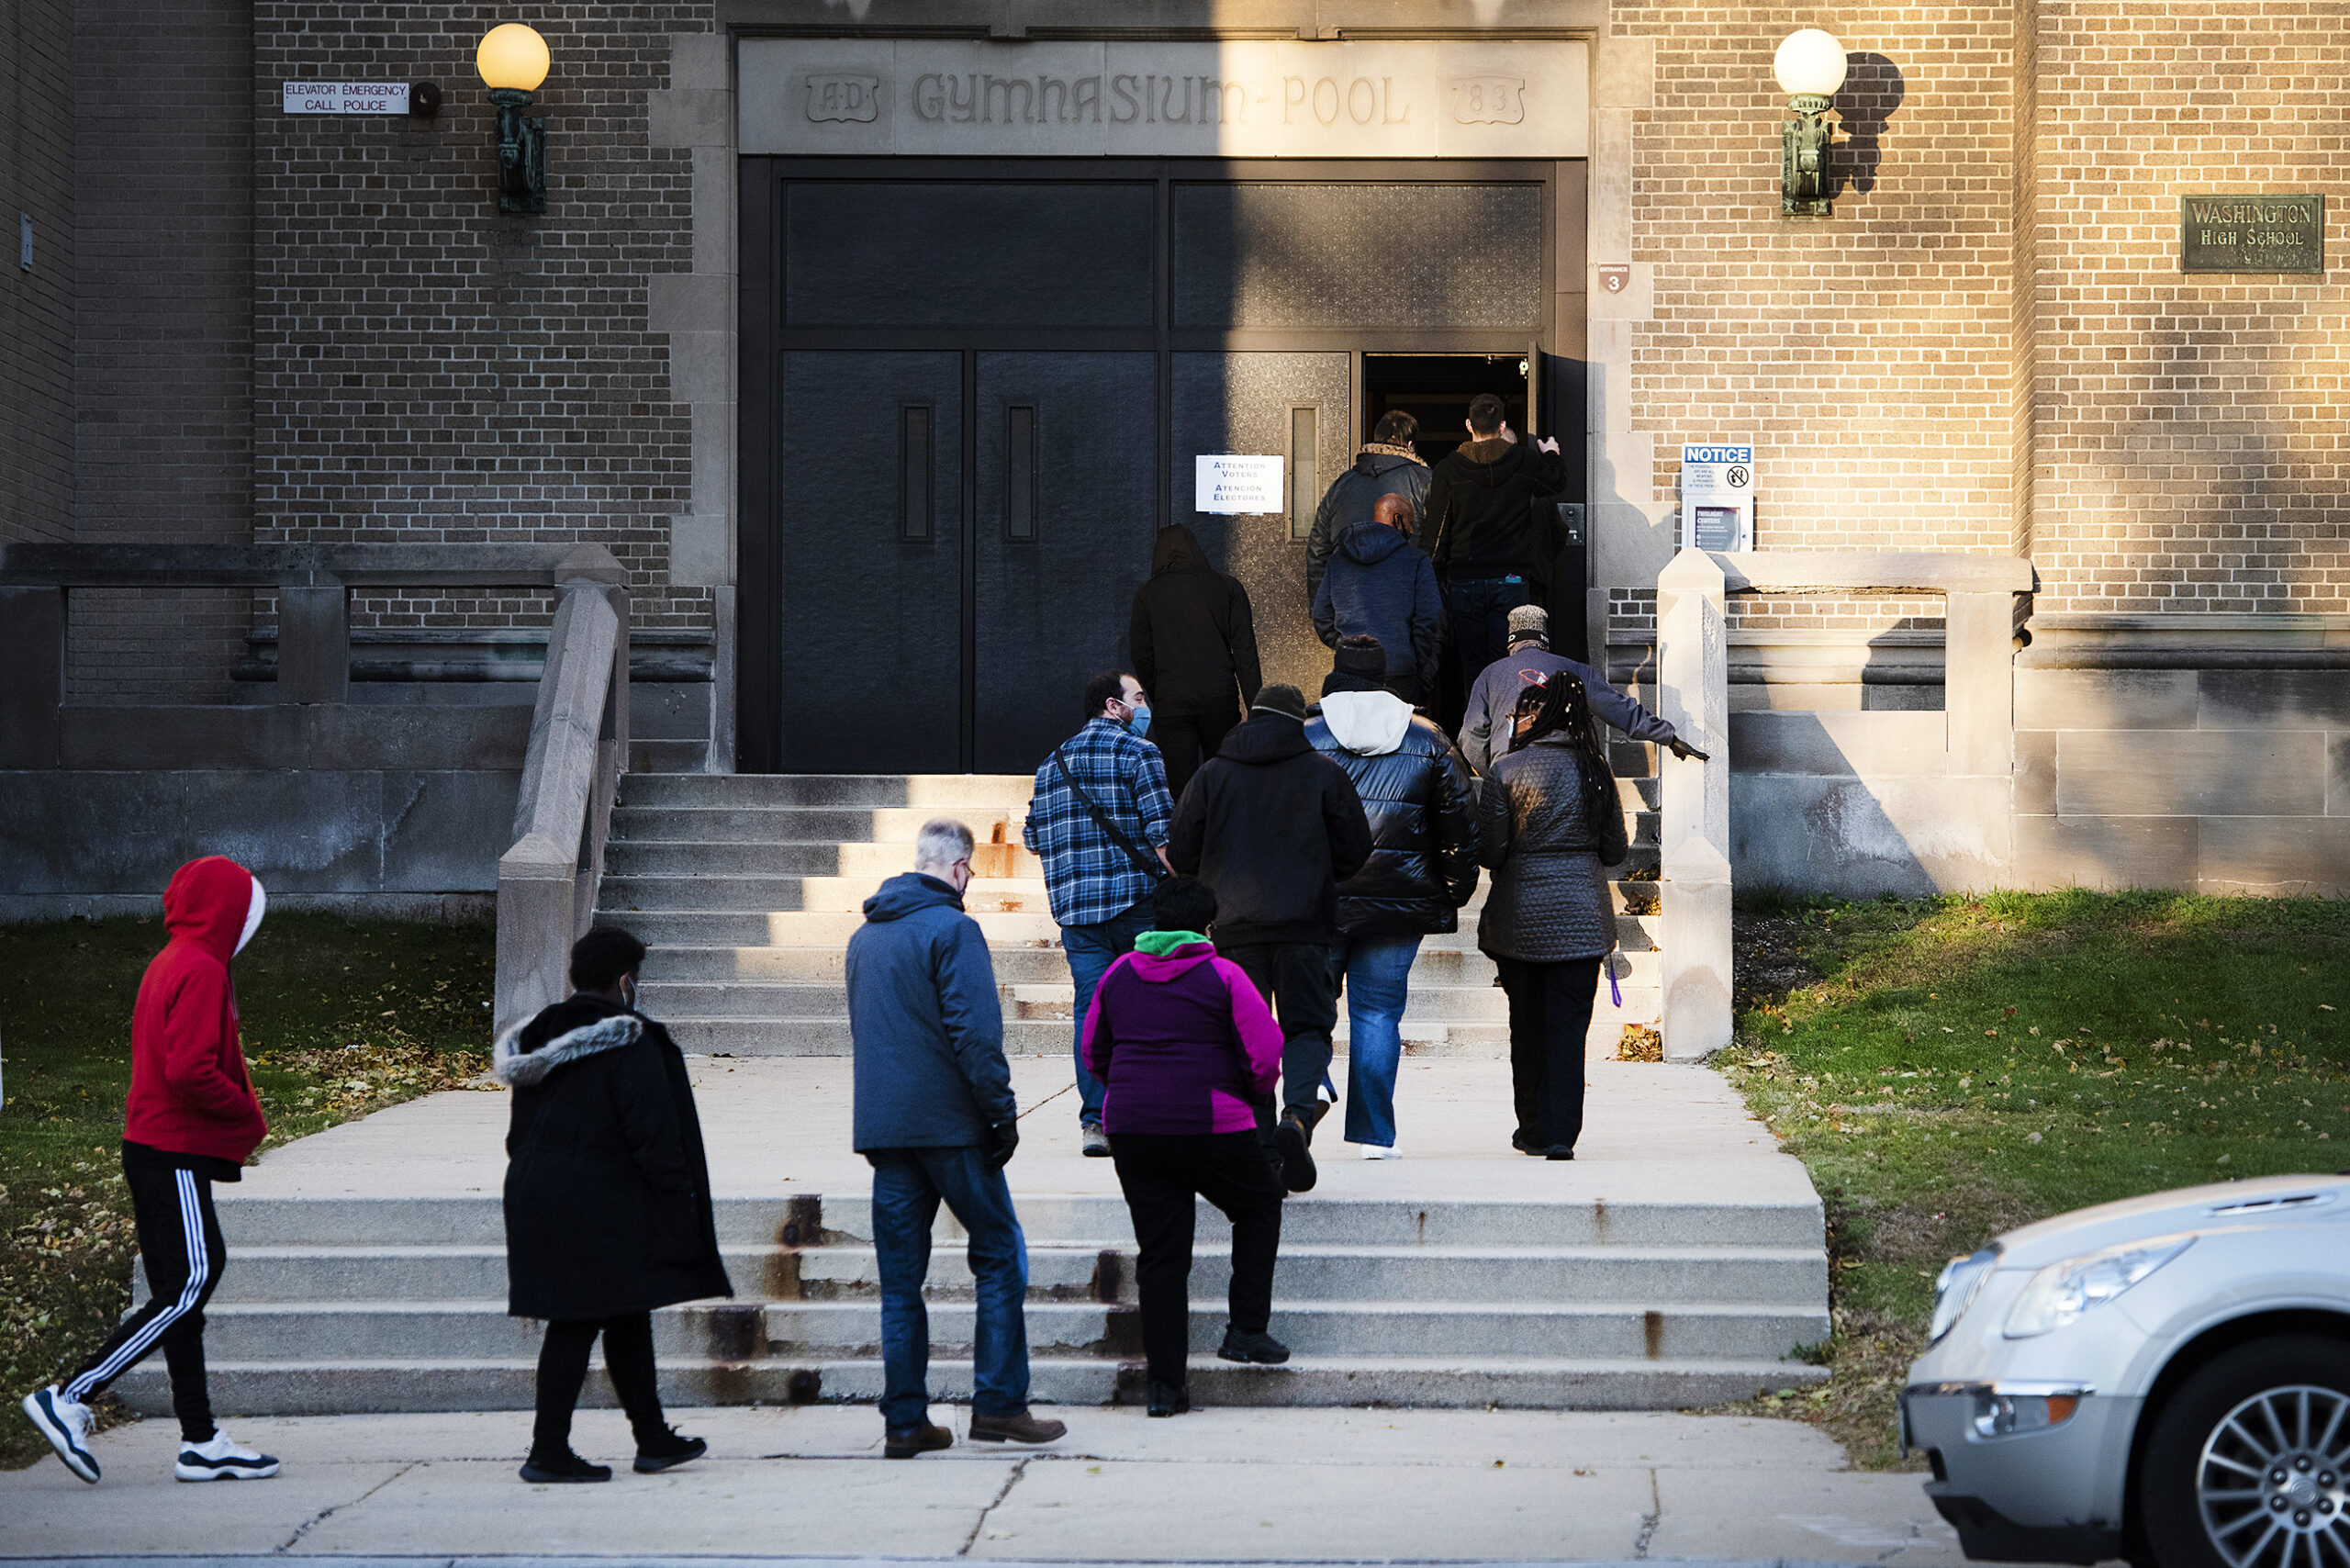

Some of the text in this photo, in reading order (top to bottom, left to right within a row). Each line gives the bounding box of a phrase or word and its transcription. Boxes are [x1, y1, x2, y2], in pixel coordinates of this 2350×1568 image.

[285, 84, 406, 95] ELEVATOR EMERGENCY
[305, 99, 386, 111] CALL POLICE
[1283, 74, 1412, 126] POOL
[2191, 203, 2311, 224] WASHINGTON
[2200, 229, 2304, 246] HIGH SCHOOL
[1608, 275, 1619, 291] 3
[1687, 448, 1748, 463] NOTICE
[1214, 493, 1266, 501] ELECTORES
